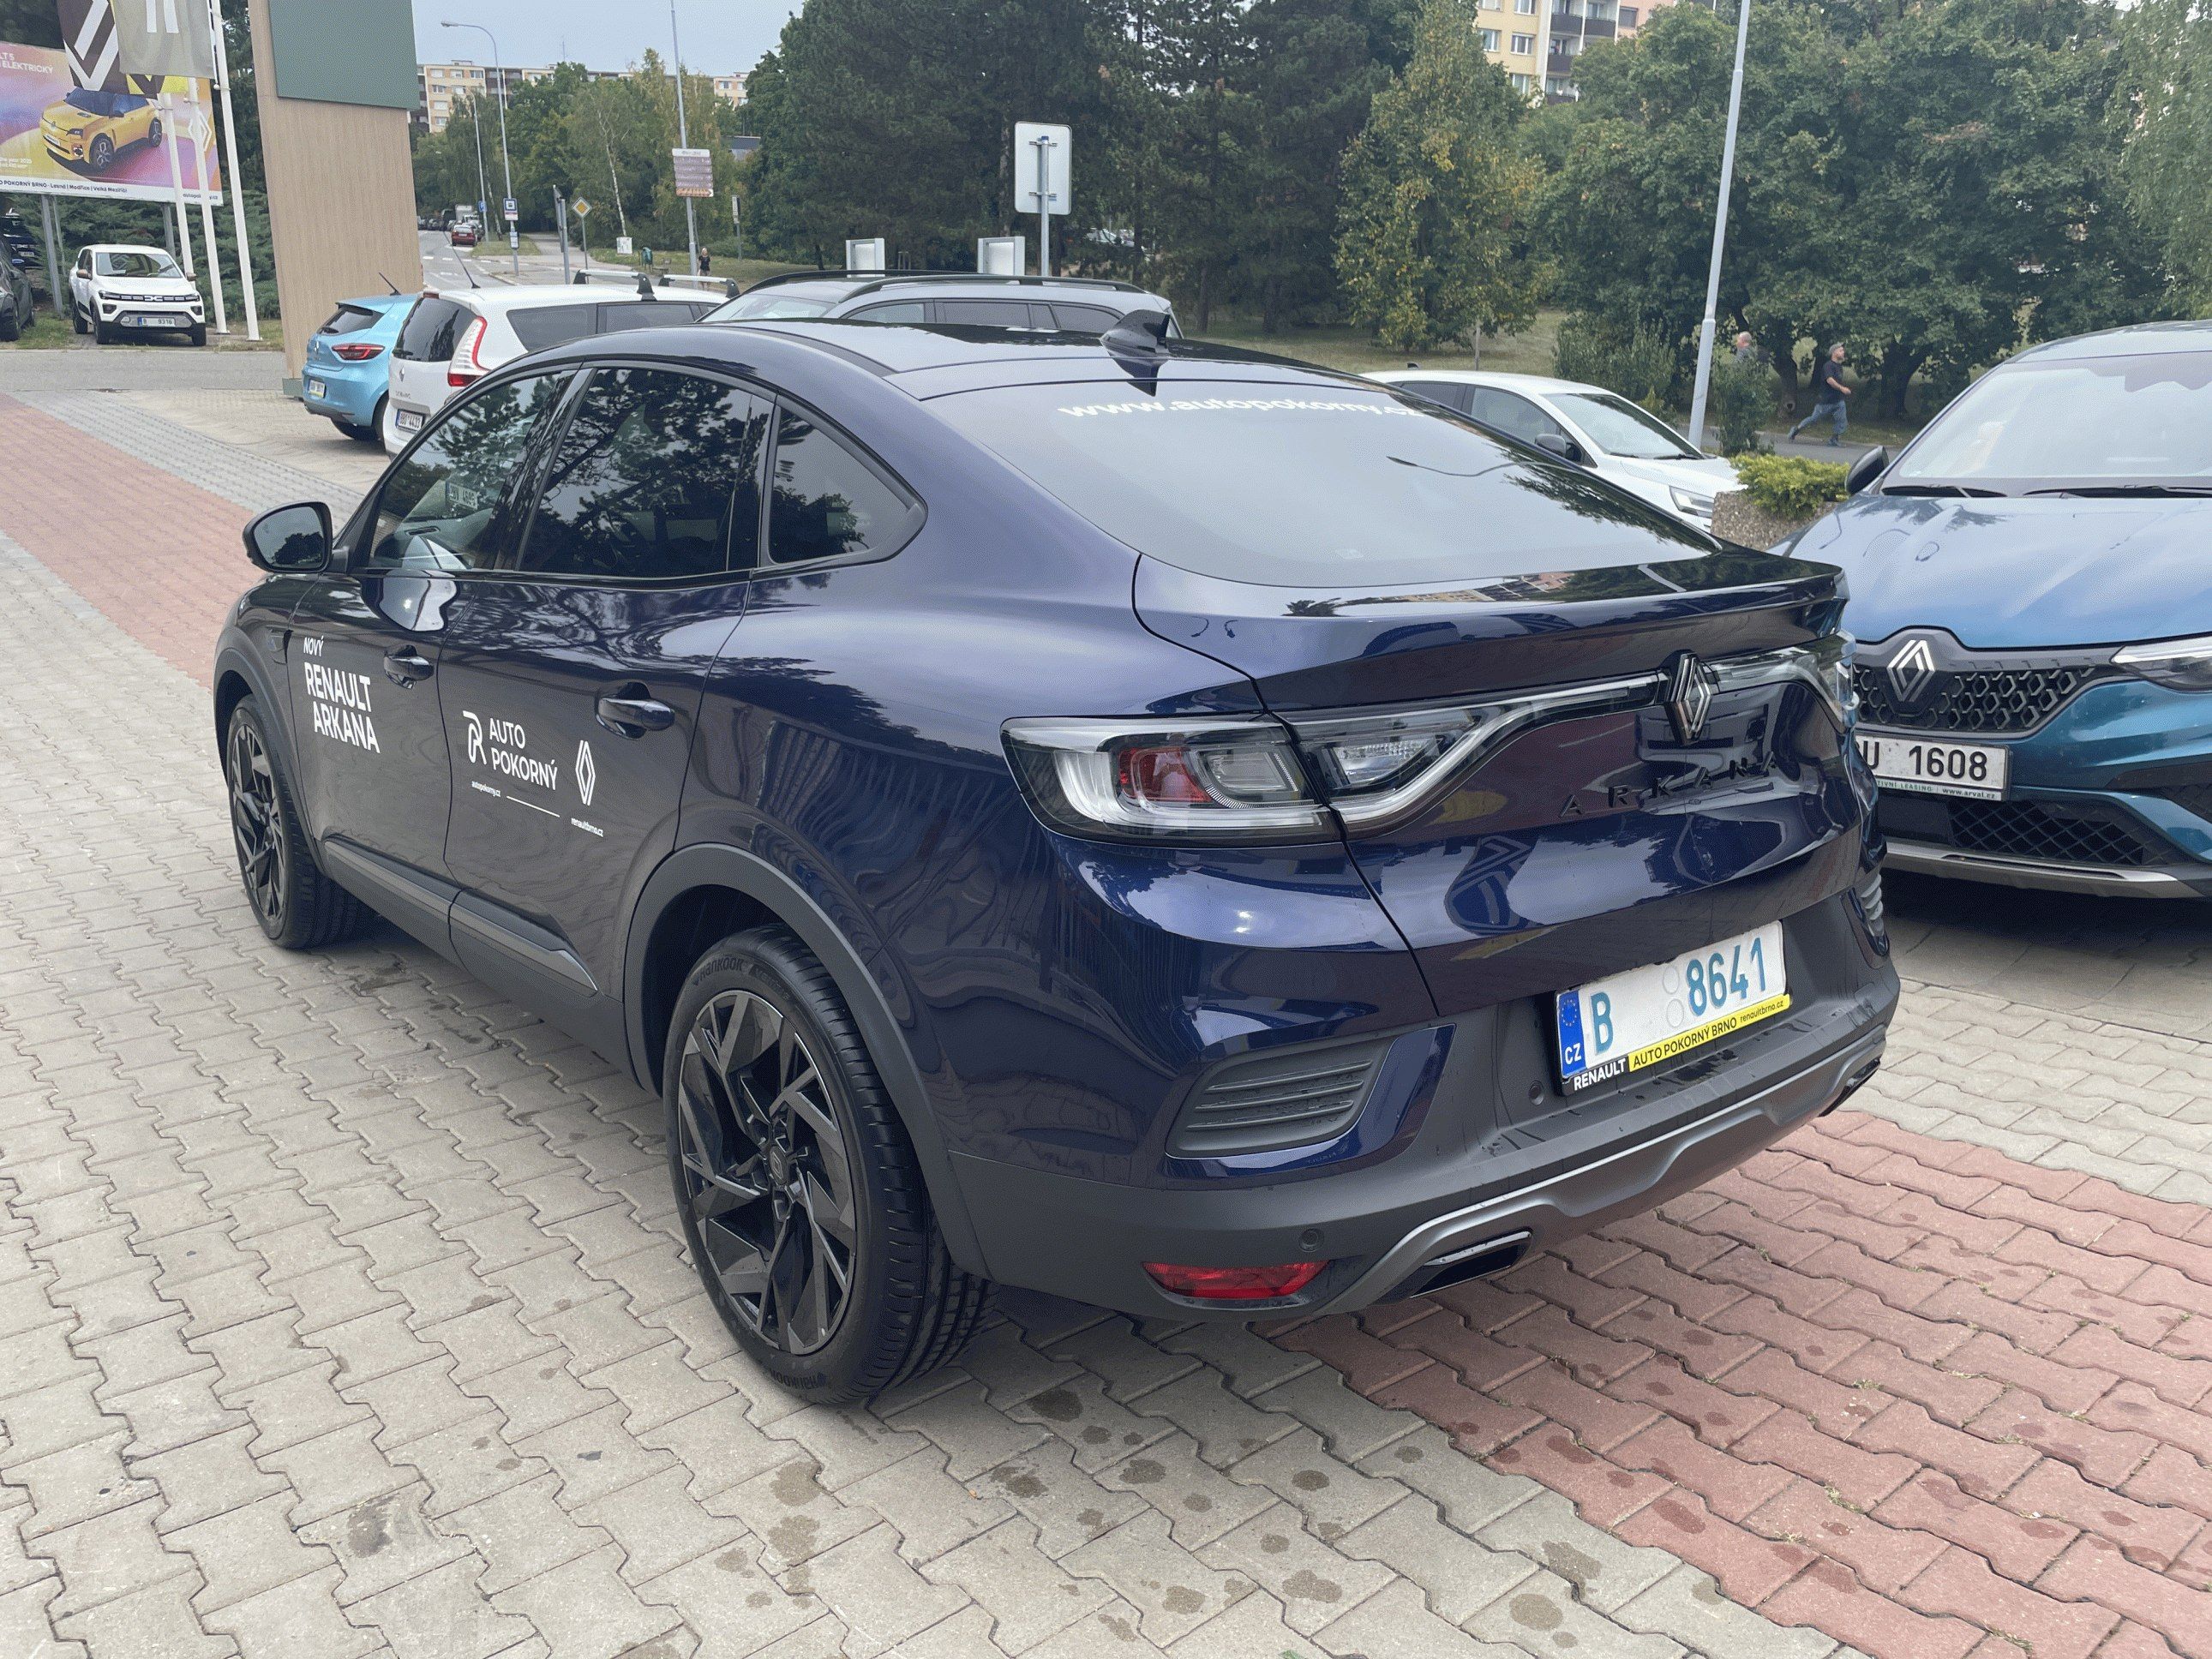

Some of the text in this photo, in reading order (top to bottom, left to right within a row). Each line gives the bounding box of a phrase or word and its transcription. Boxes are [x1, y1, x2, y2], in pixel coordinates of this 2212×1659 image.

[303, 635, 324, 657] NOVÝ
[304, 661, 371, 713] RENAULT
[313, 701, 381, 754] ARKANA
[489, 717, 526, 749] AUTO
[491, 747, 558, 791] POKORNÝ
[1558, 751, 1777, 818] ARKANA
[1909, 746, 1987, 782] 1608
[1900, 782, 1933, 792] LEASING
[1591, 937, 1765, 1056] B 8641
[1565, 1043, 1581, 1065] CZ
[1574, 998, 1784, 1091] RENAULT AUTO POKORNÝ BRNO renaultbrno.cz
